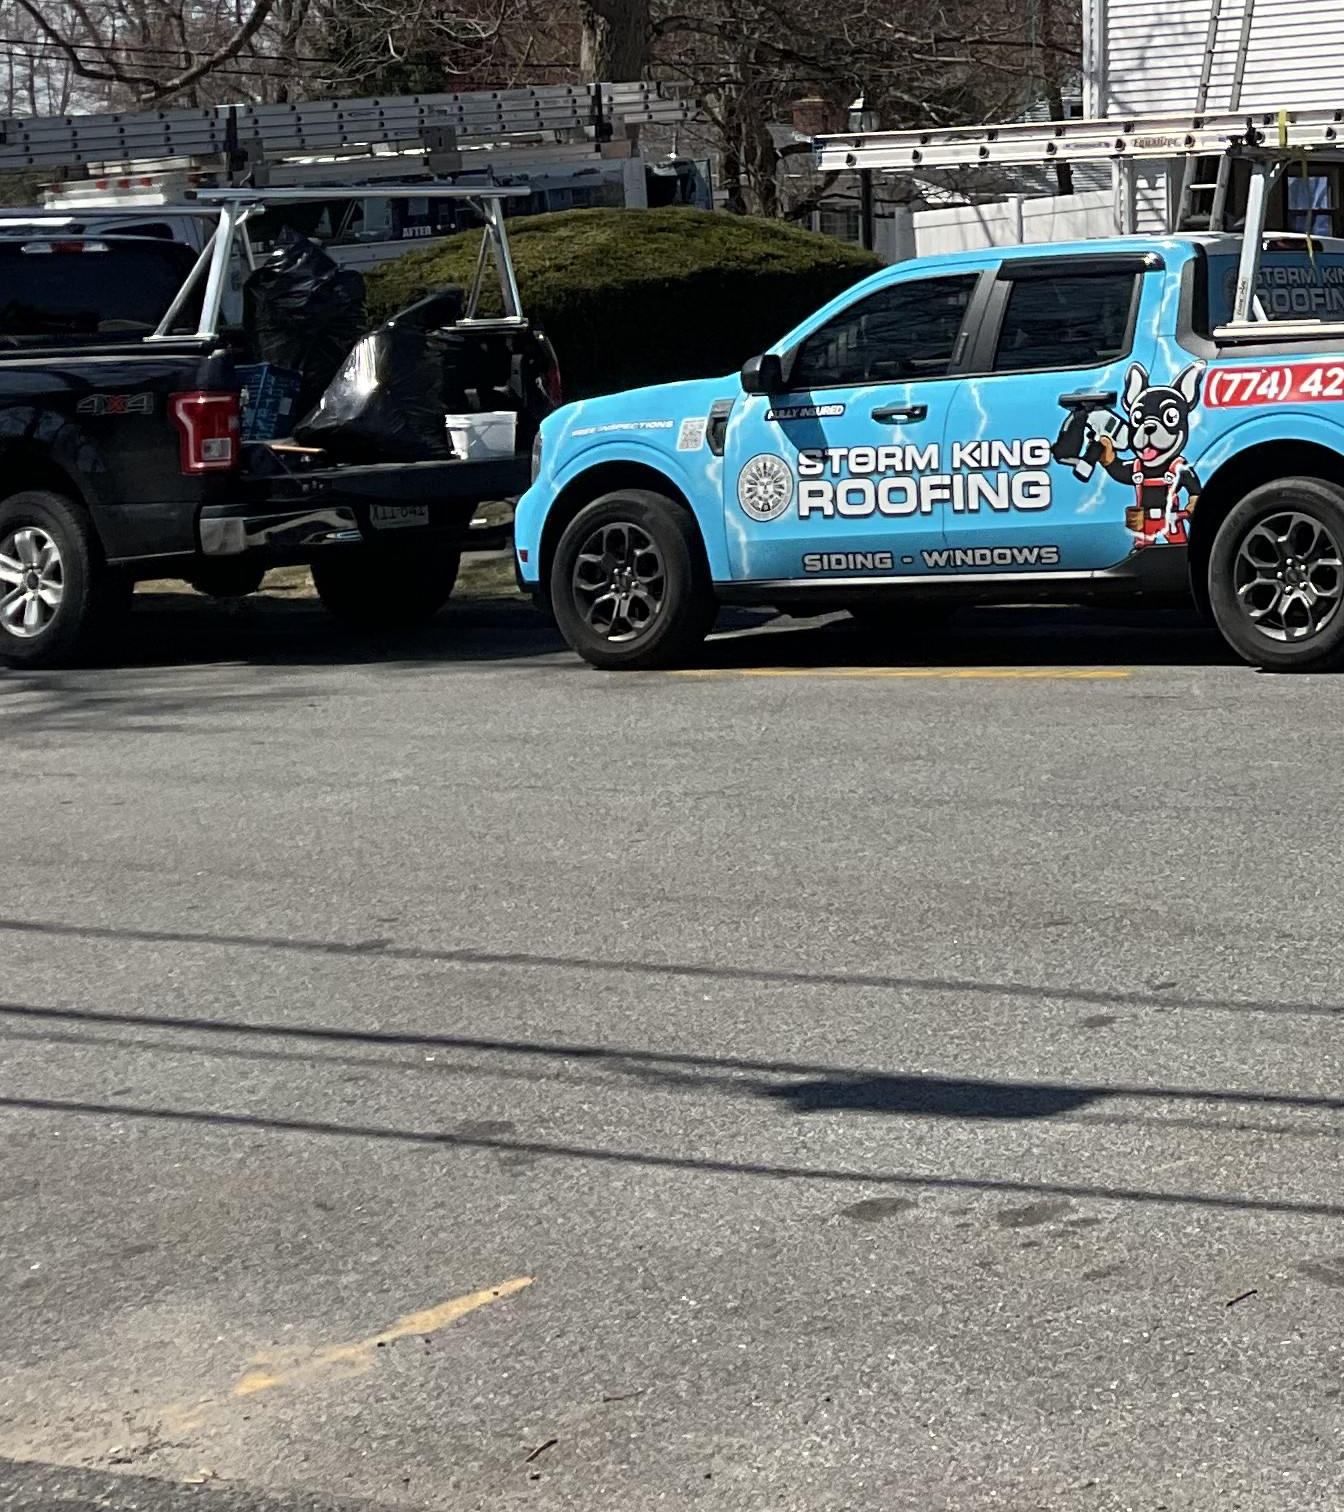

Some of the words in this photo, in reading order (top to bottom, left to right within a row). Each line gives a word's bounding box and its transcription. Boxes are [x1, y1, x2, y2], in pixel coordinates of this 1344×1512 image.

[402, 225, 432, 238] AFTER
[1209, 367, 1293, 405] (774)
[766, 408, 798, 420] FULLY
[799, 404, 845, 418] INSURED
[797, 441, 940, 476] STORM
[951, 437, 1052, 469] KING
[797, 469, 1052, 519] ROOFING
[803, 552, 894, 572] SIDING
[921, 546, 1060, 568] WINDOWS
